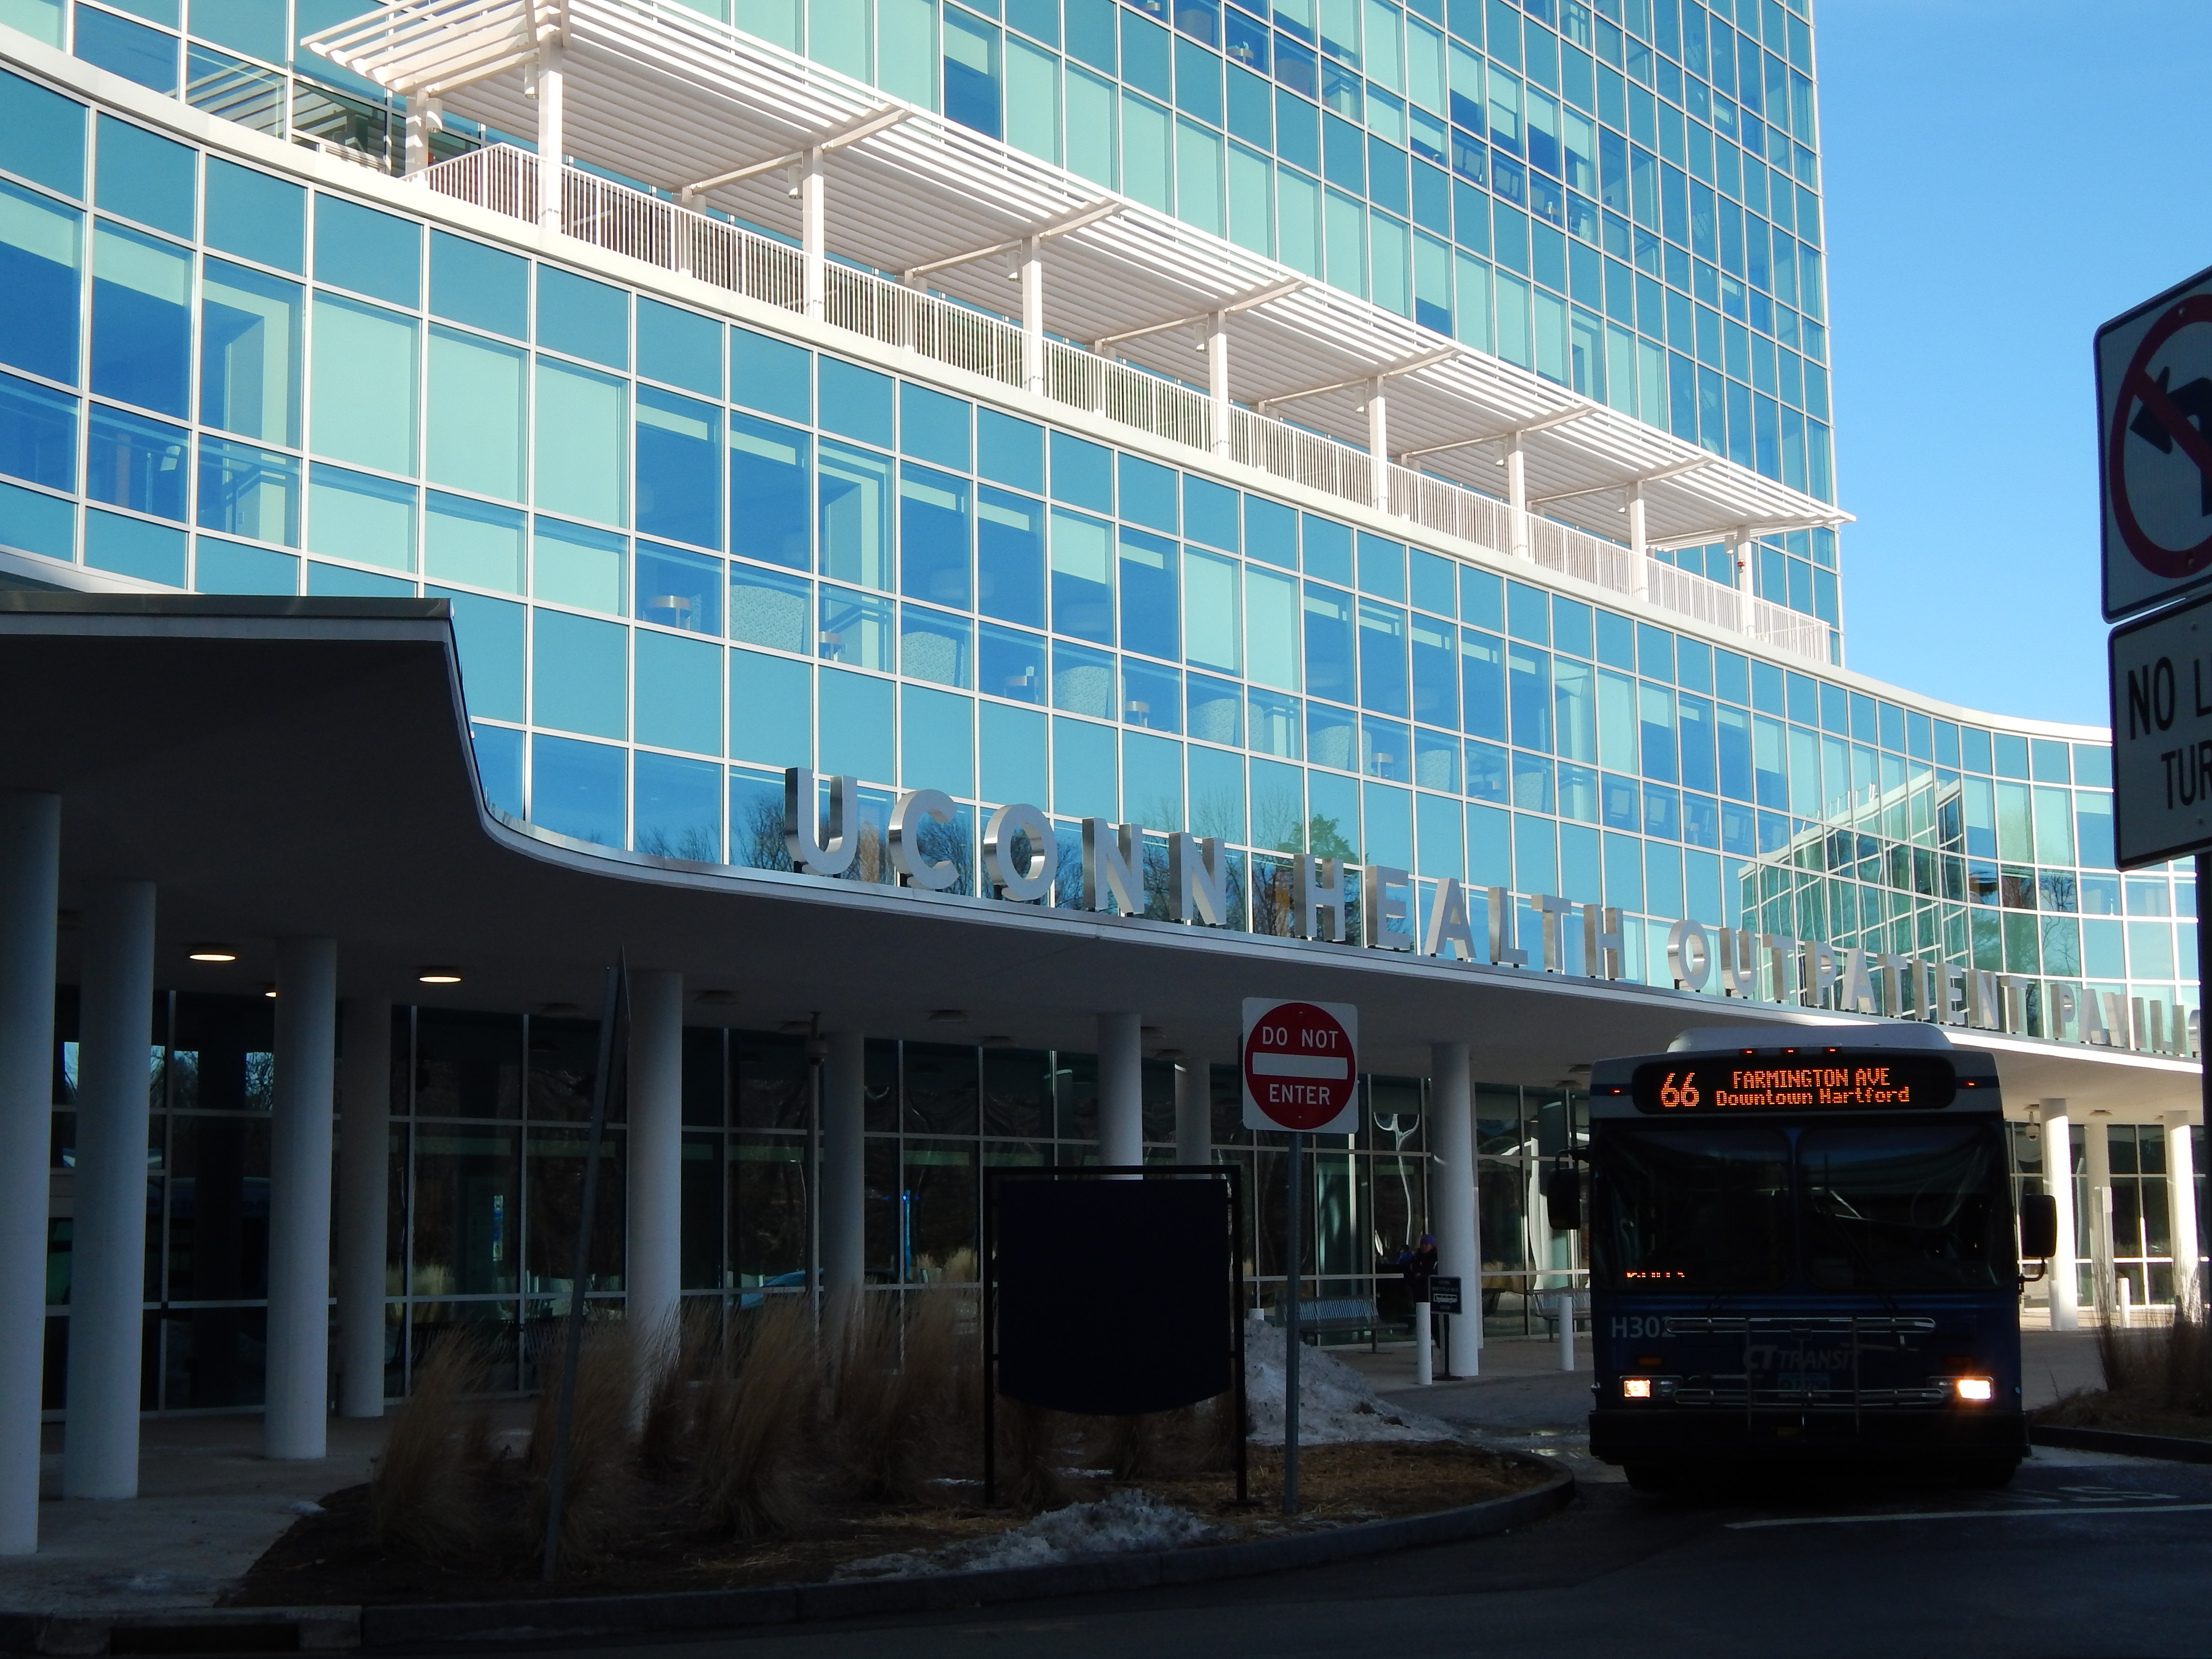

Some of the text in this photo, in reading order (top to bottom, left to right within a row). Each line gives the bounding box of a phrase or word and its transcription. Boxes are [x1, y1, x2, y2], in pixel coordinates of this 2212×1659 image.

[2128, 654, 2212, 740] NO L
[784, 767, 1227, 926] UCONN
[1293, 853, 1626, 981] HEALTH
[1667, 919, 2028, 1034] OUTPATIENT
[1262, 1026, 1339, 1049] DO NOT
[1660, 1072, 1700, 1107] 66
[1732, 1068, 1891, 1089] FARMINGTON AVE
[1269, 1083, 1330, 1105] ENTER
[1716, 1086, 1910, 1106] Downtown Hartford
